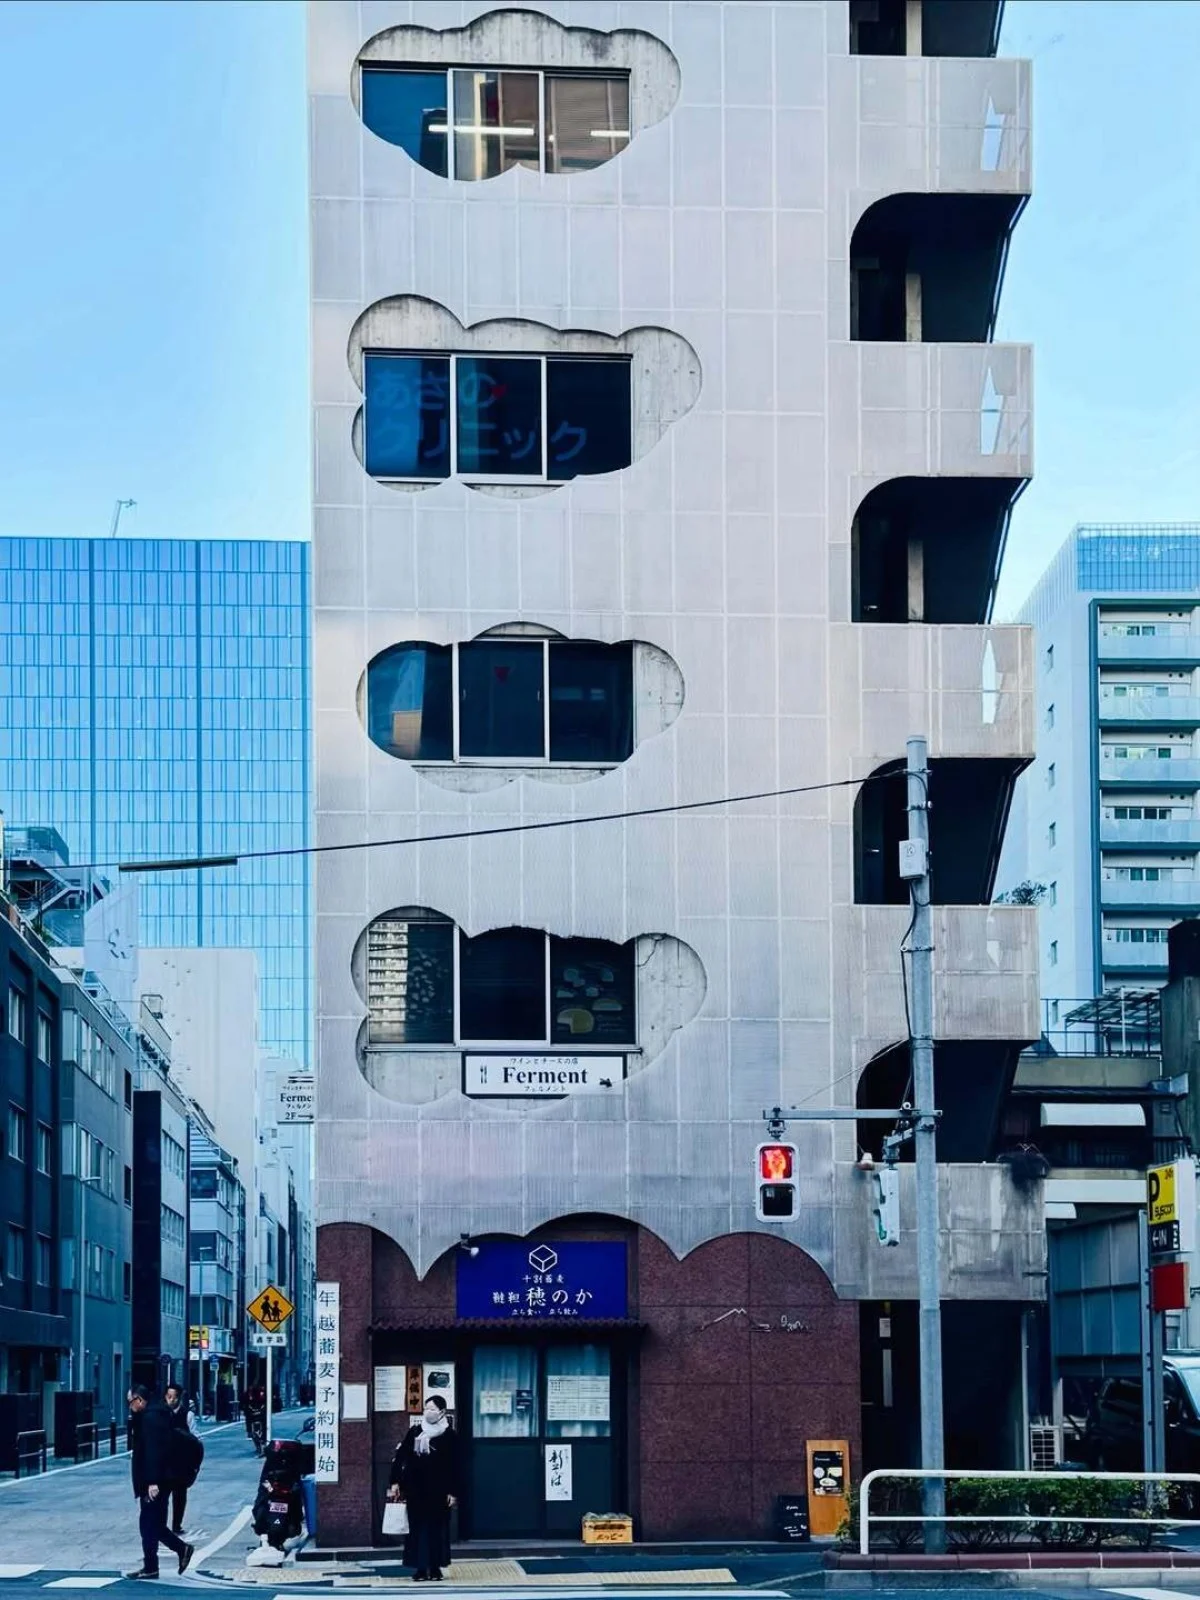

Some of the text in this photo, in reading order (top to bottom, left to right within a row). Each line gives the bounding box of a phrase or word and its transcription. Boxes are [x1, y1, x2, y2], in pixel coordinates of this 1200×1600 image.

[373, 418, 587, 461] クリニック
[503, 1066, 588, 1084] Ferment
[285, 1111, 296, 1120] 2F
[1148, 1171, 1160, 1221] P
[318, 1290, 336, 1473] 年越蕎麦予約開始
